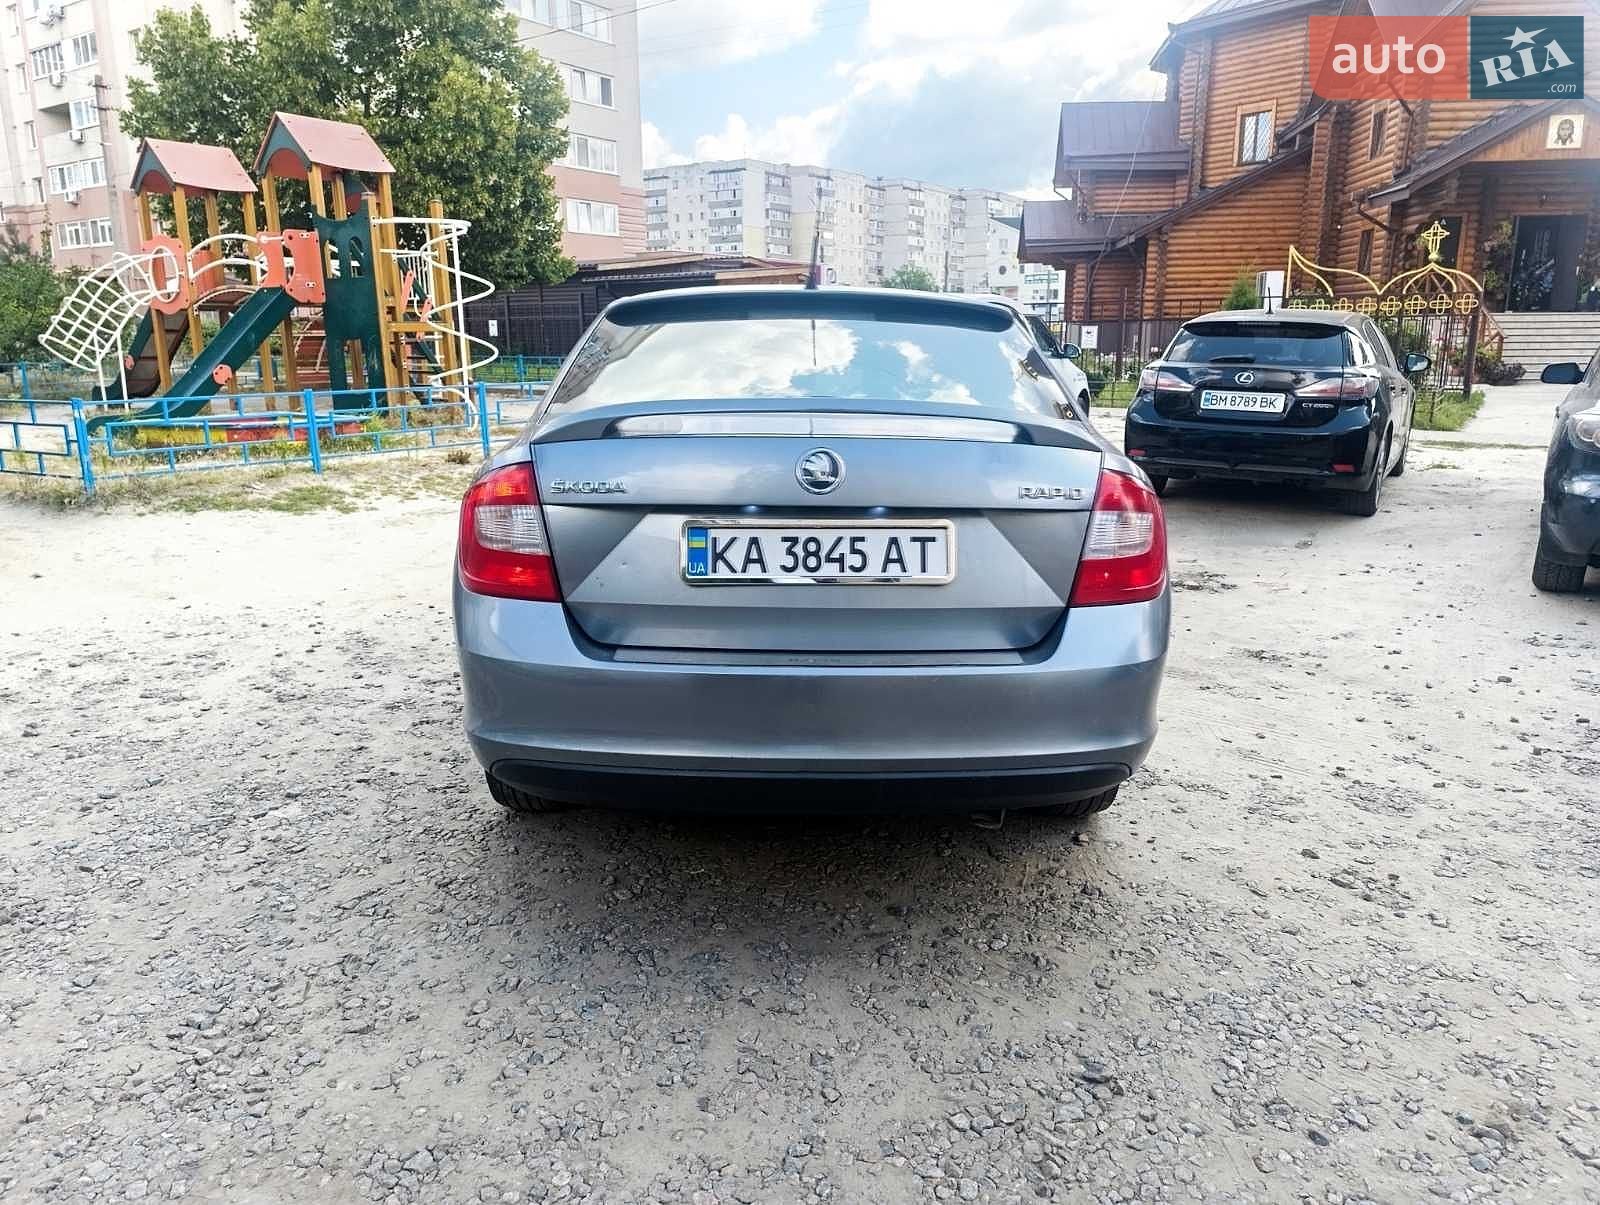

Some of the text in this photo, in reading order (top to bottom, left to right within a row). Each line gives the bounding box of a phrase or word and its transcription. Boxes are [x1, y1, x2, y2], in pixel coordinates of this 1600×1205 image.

[1210, 394, 1278, 409] BM 8789 BK
[1018, 486, 1083, 501] RAPID
[710, 536, 937, 574] KA 3845 AT
[688, 561, 706, 575] UA
